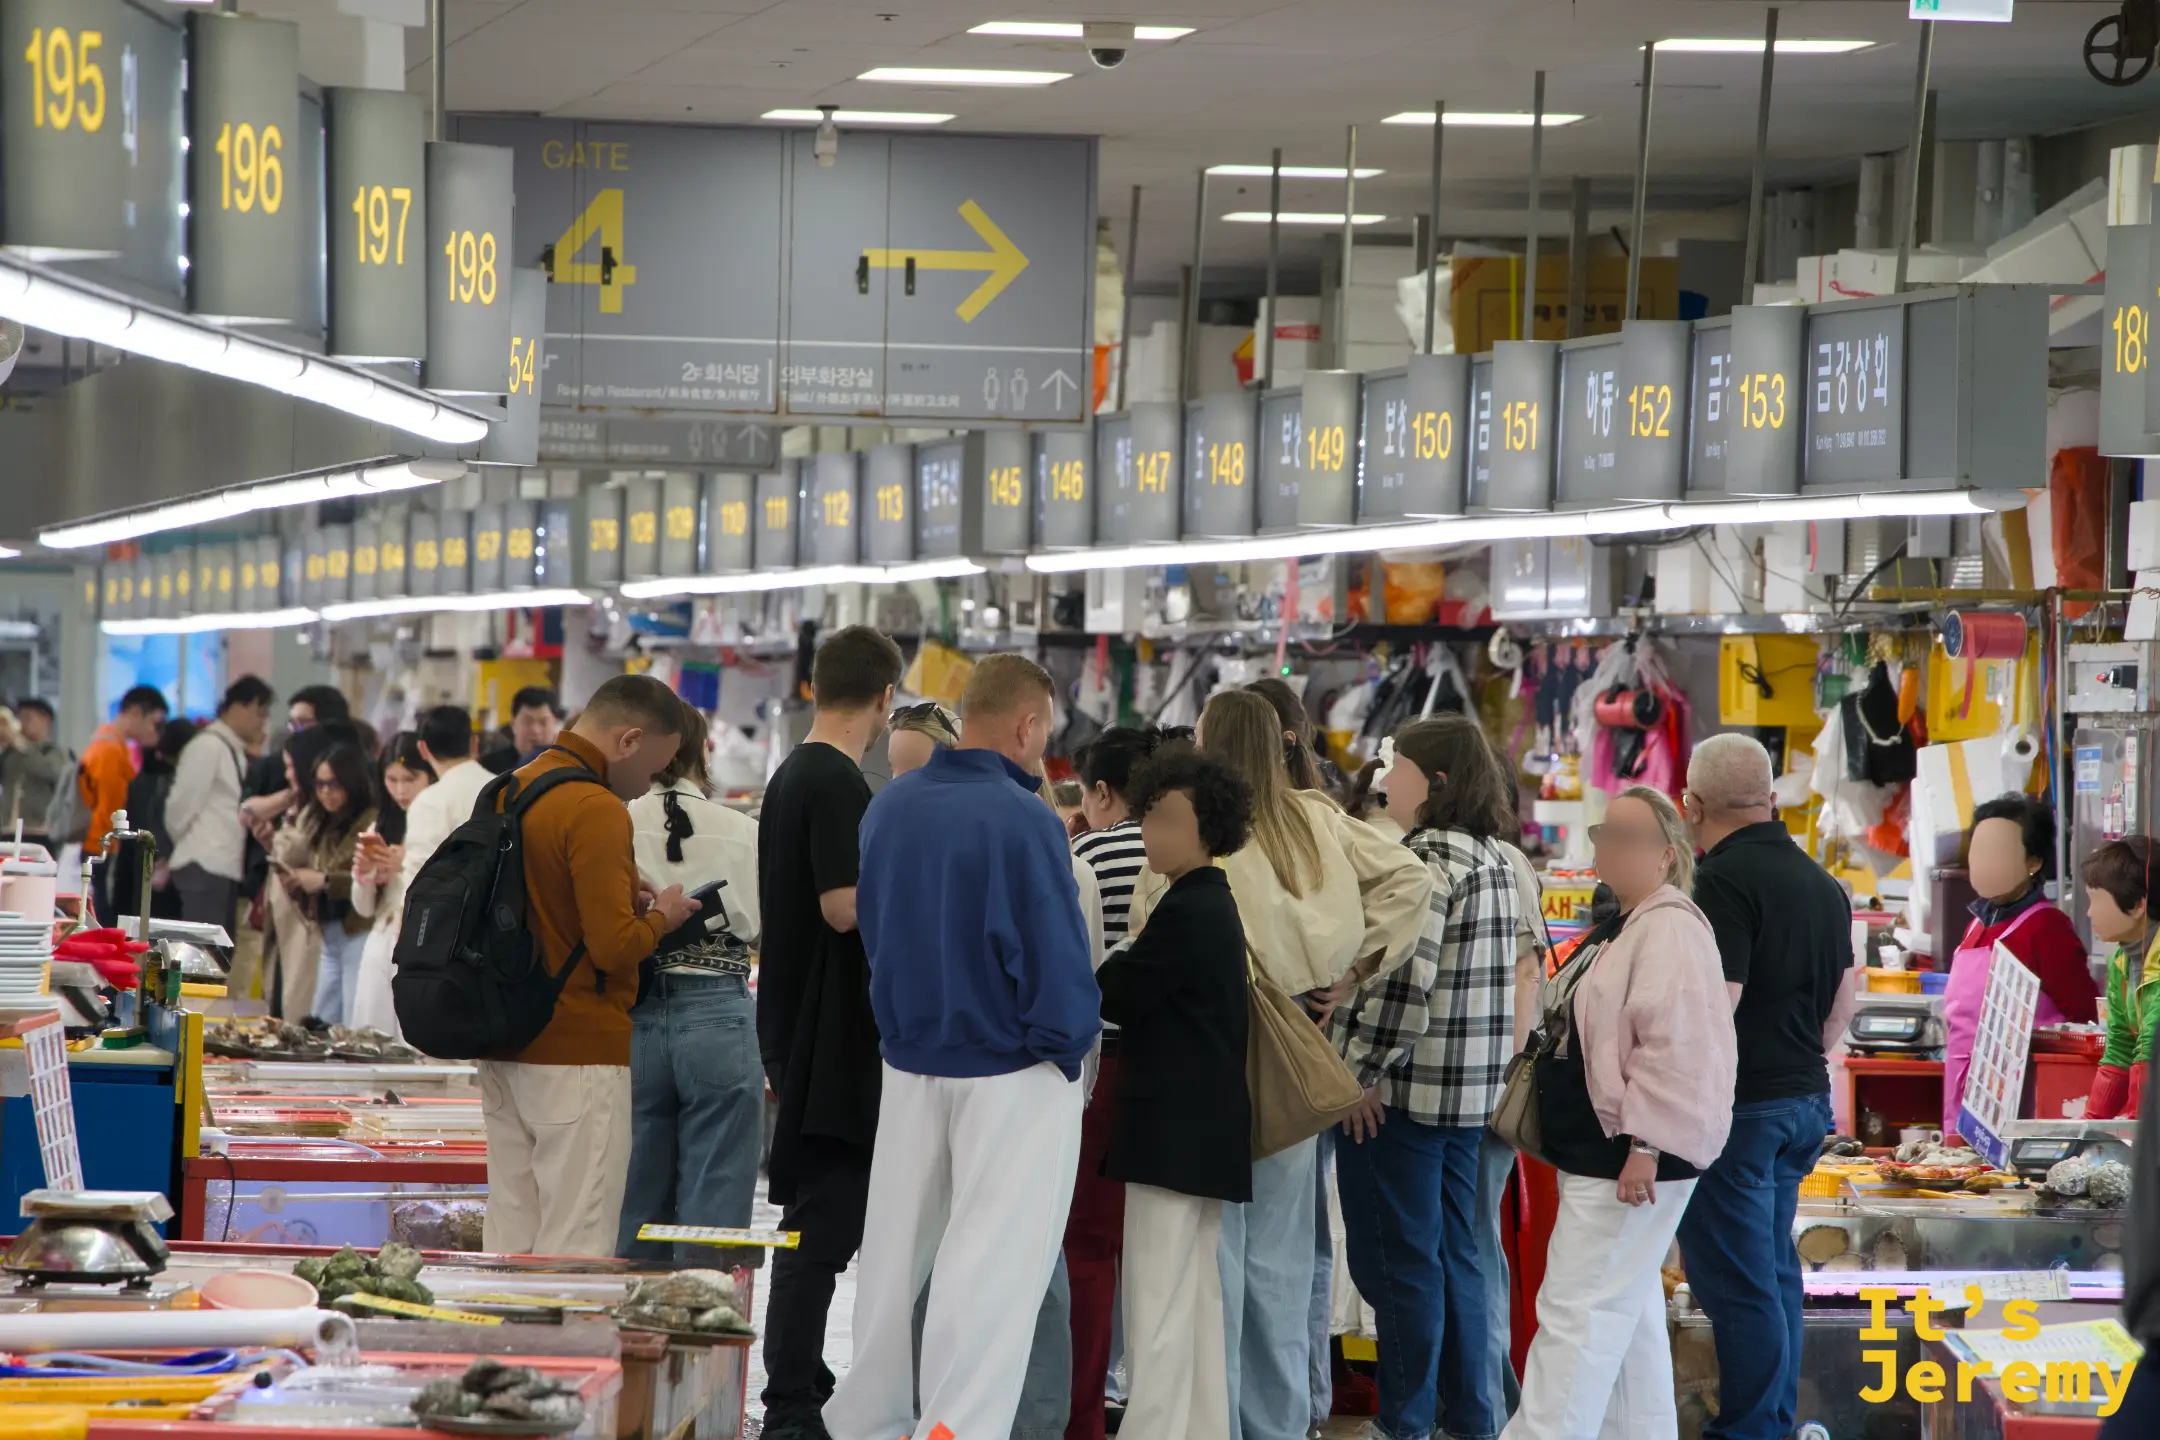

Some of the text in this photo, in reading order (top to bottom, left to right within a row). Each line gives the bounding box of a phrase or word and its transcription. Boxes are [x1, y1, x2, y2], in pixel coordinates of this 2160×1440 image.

[23, 26, 106, 133] 195
[215, 121, 283, 215] 196
[542, 140, 630, 171] GATE
[351, 184, 413, 266] 197
[444, 230, 497, 306] 198
[553, 188, 636, 313] 4
[509, 336, 535, 395] 54
[779, 364, 874, 389] 외부화장실
[1817, 332, 1889, 415] 금강상회
[1502, 400, 1538, 451] 151
[1587, 371, 1620, 437] 하동
[1627, 384, 1672, 438] 152
[1739, 372, 1785, 430] 153
[1307, 425, 1345, 472] 149
[1412, 411, 1452, 460] 150
[989, 466, 1022, 507] 145
[1051, 460, 1083, 502] 146
[1136, 451, 1171, 492] 147
[1209, 441, 1245, 487] 148
[765, 497, 788, 528] 111
[823, 490, 849, 527] 112
[877, 484, 904, 521] 113
